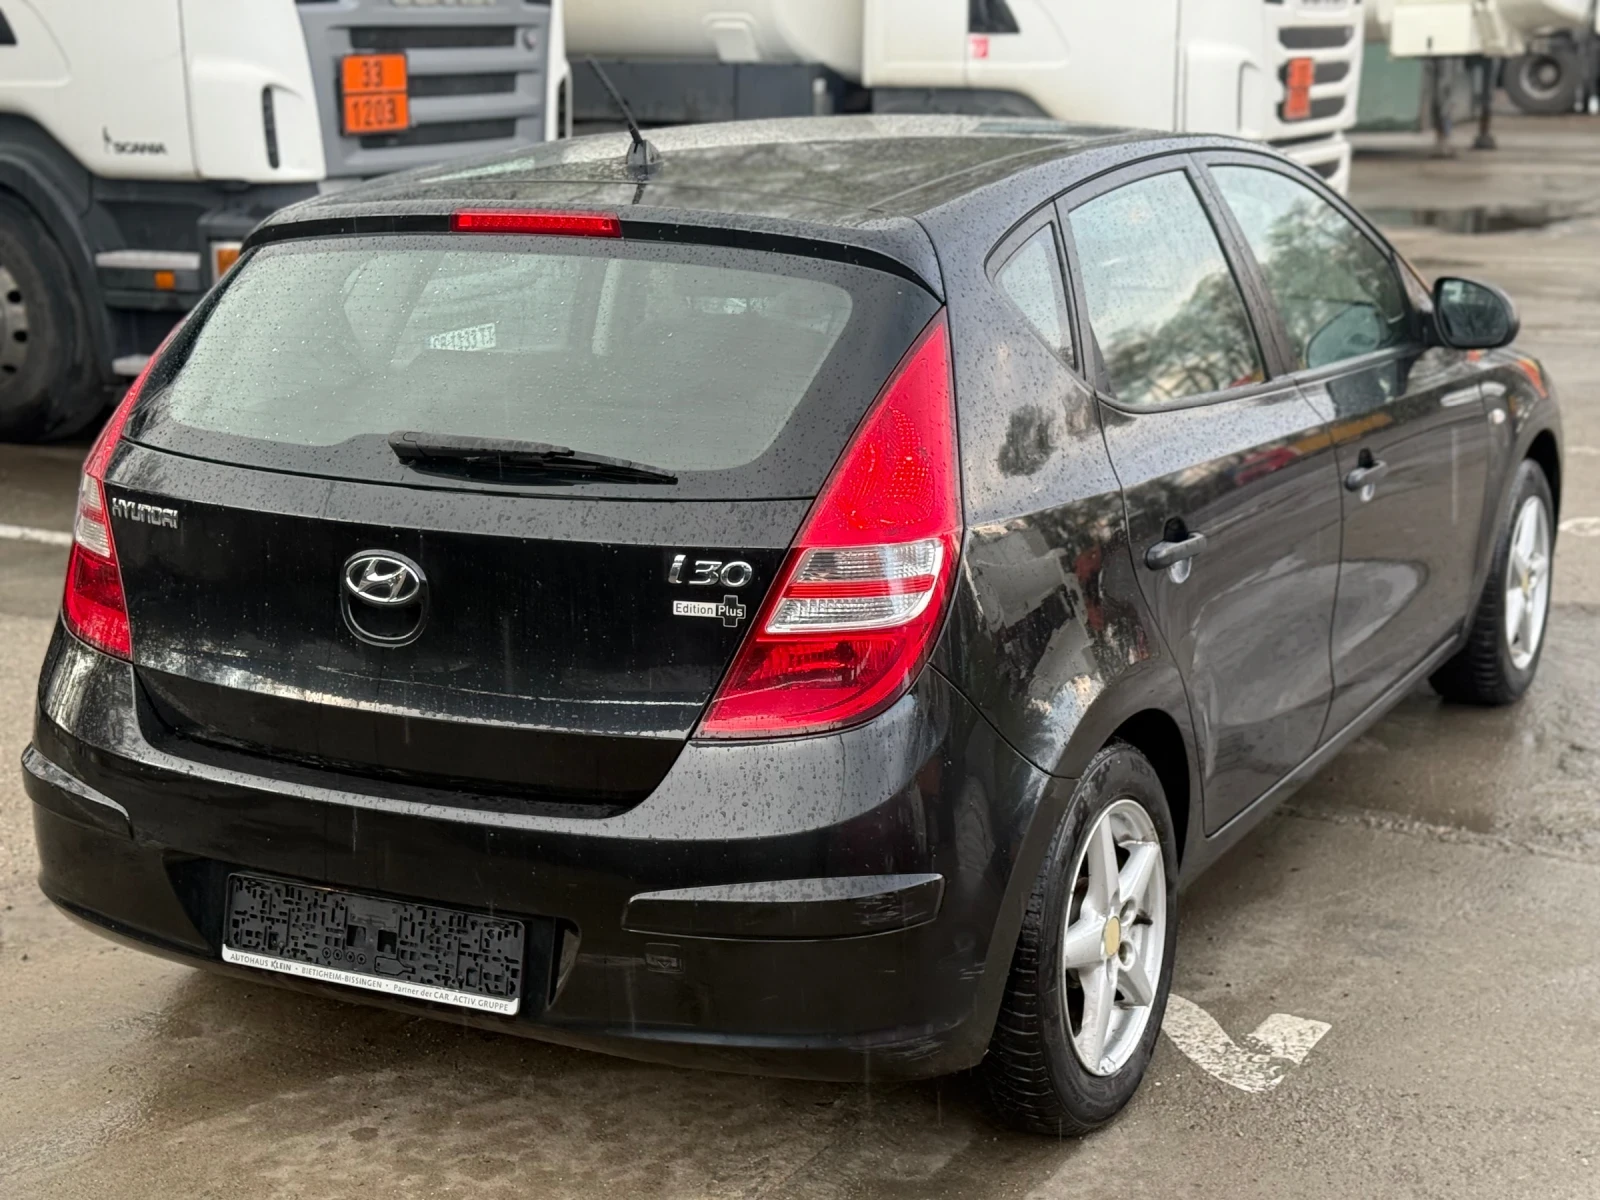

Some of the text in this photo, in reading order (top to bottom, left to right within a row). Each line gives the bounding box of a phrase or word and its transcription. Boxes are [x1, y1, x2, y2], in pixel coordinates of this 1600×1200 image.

[361, 60, 383, 88] 33
[352, 98, 397, 128] 1203
[112, 497, 178, 529] HYUNDAI
[675, 602, 743, 617] Edition Plus
[230, 953, 269, 967] AUTOHAUS
[270, 960, 292, 971] KLEIN
[301, 966, 383, 989] BIETIGHEIM-BISSINGEN
[393, 984, 419, 996] Partner
[420, 987, 432, 998] der
[478, 999, 509, 1011] GRUPPE
